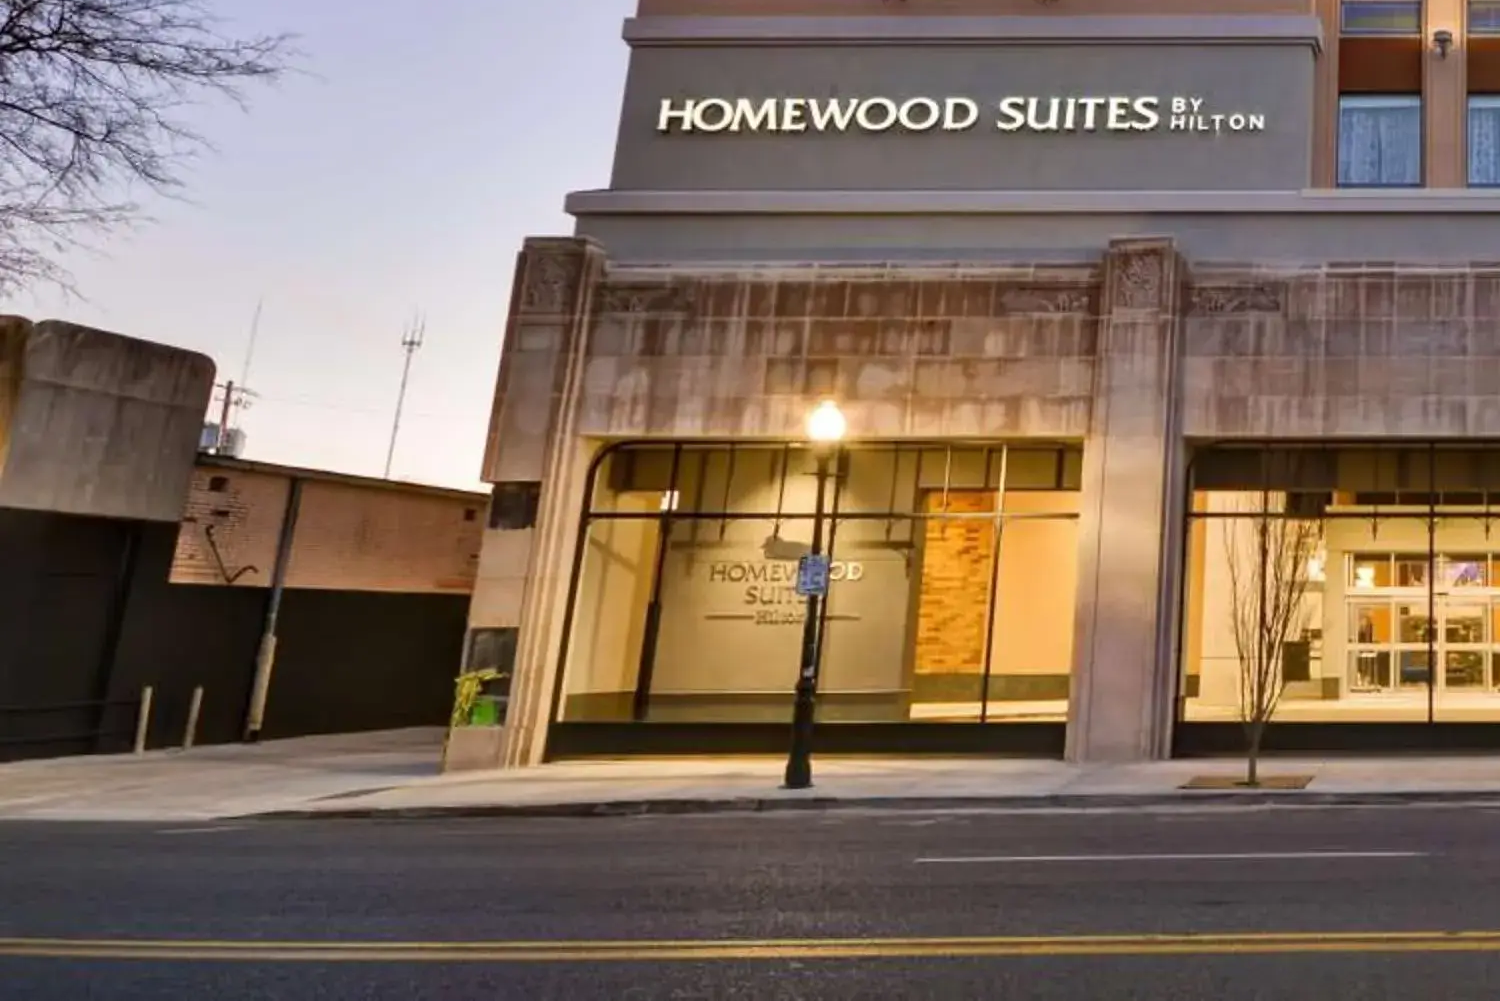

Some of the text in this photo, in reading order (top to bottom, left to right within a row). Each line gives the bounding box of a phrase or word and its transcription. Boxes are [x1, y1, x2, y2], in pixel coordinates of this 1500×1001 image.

[656, 96, 1160, 132] HOMEWOOD SUITES
[1170, 97, 1203, 114] BY
[1169, 114, 1266, 131] HILTON
[709, 561, 864, 583] HOMEWOD
[745, 584, 808, 605] SUIT
